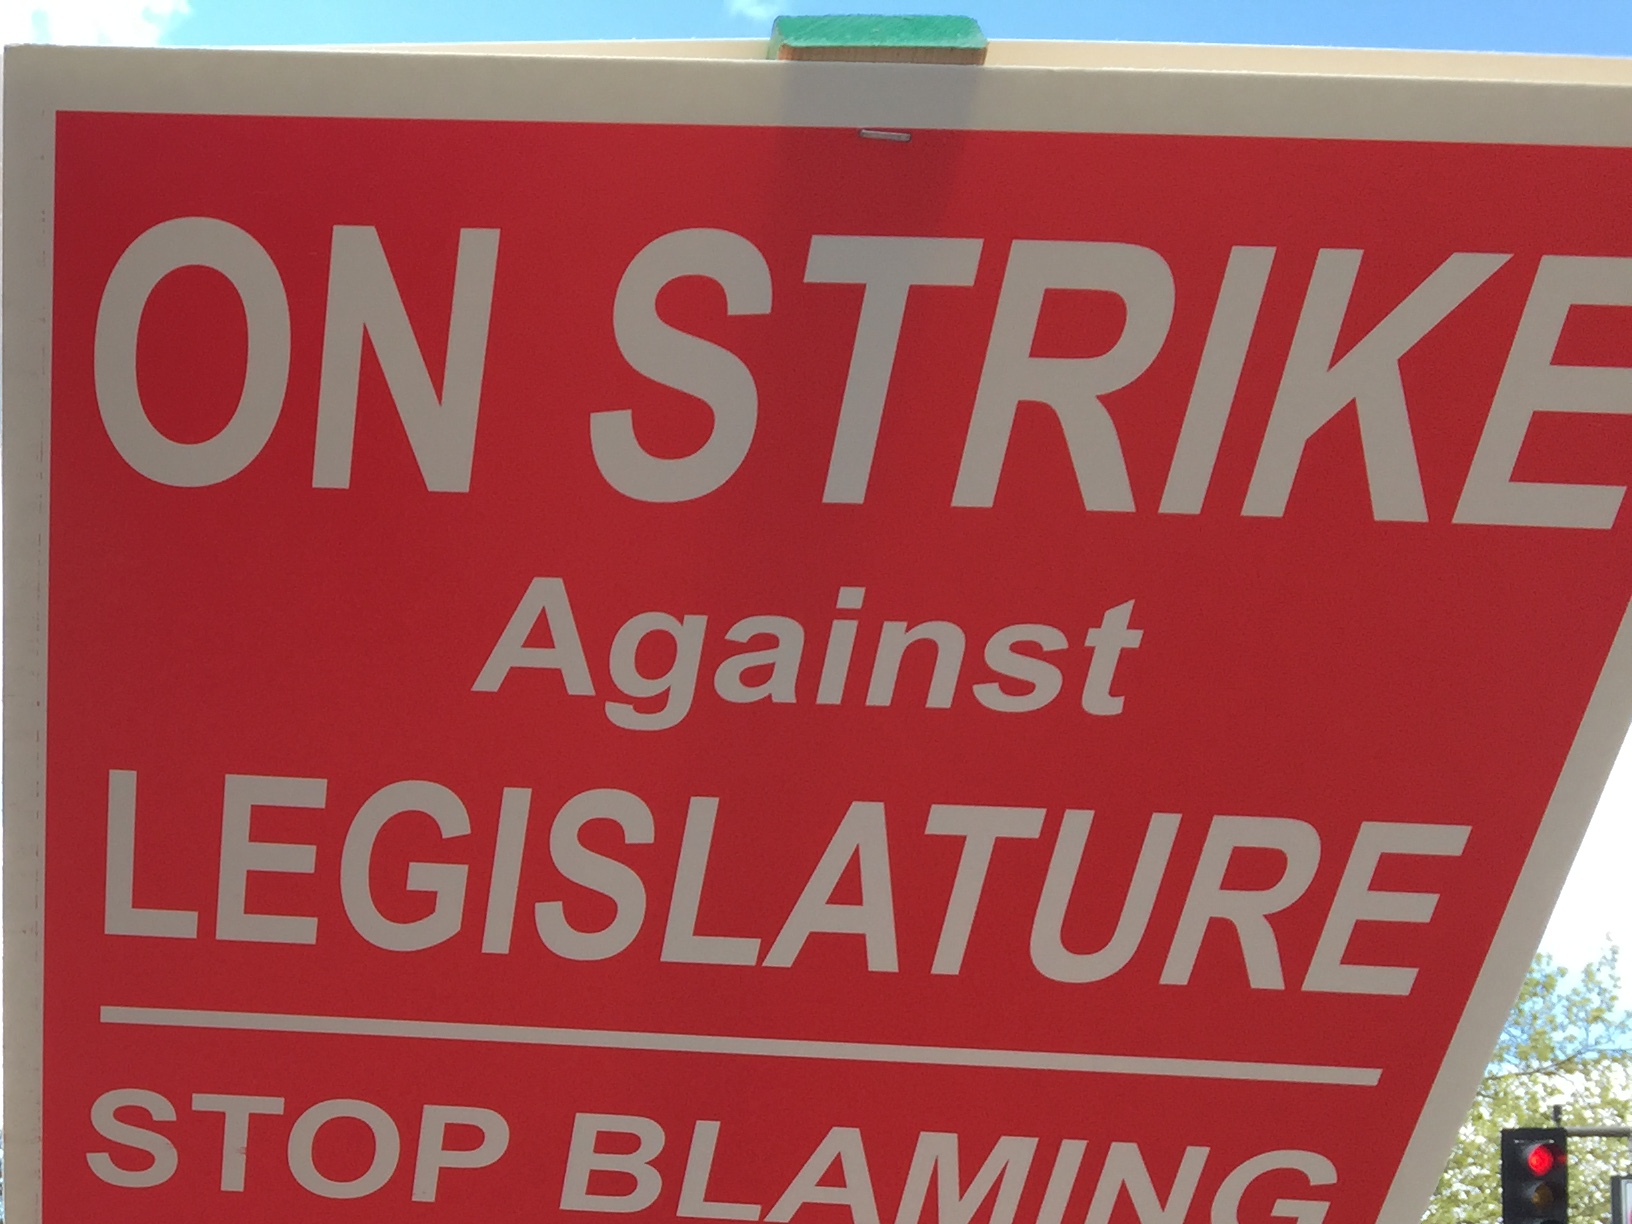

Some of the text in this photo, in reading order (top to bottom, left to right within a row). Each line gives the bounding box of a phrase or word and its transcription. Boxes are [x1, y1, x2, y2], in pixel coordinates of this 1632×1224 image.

[95, 217, 1632, 529] ON STRIKE
[471, 577, 1143, 735] Against
[105, 770, 1472, 995] LEGISLATURE
[87, 1089, 509, 1203] STOP
